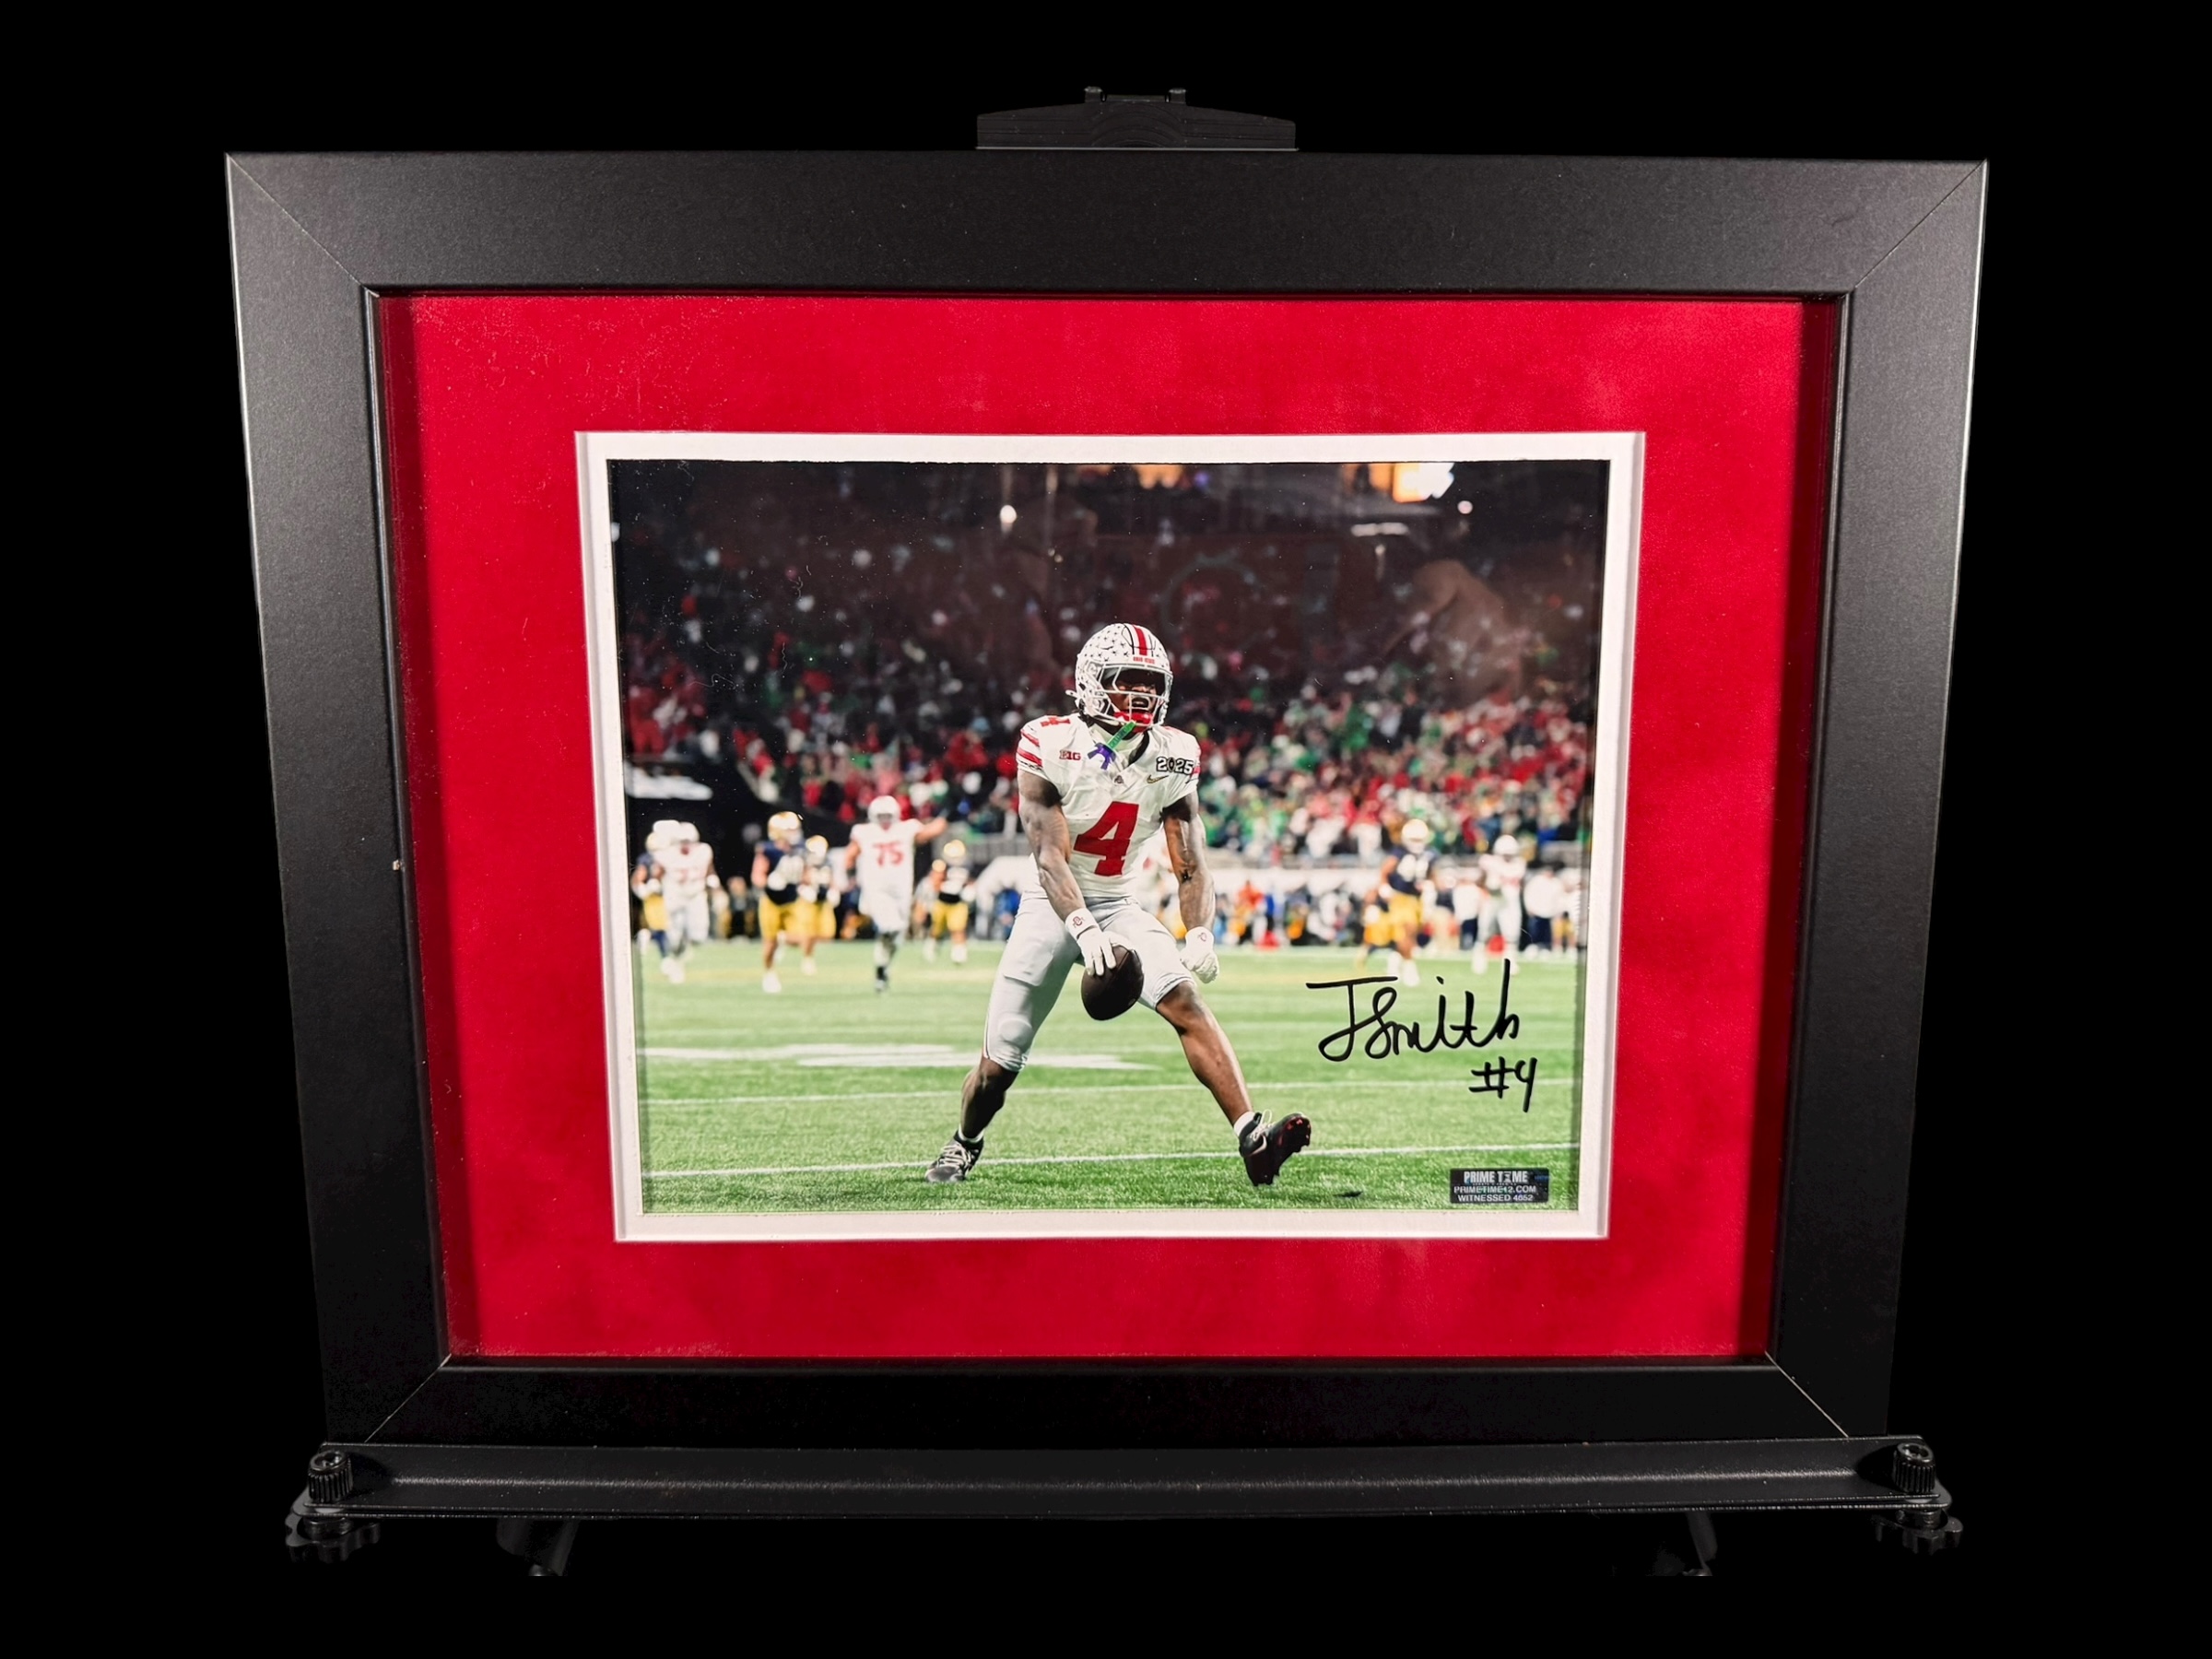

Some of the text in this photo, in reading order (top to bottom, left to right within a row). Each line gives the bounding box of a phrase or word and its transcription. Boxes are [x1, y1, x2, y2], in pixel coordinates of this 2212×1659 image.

[1156, 756, 1195, 776] 2025
[1073, 801, 1139, 877] 4
[872, 841, 904, 867] 75
[1464, 1171, 1495, 1183] PRIME
[1457, 1194, 1511, 1202] WITNESSED
